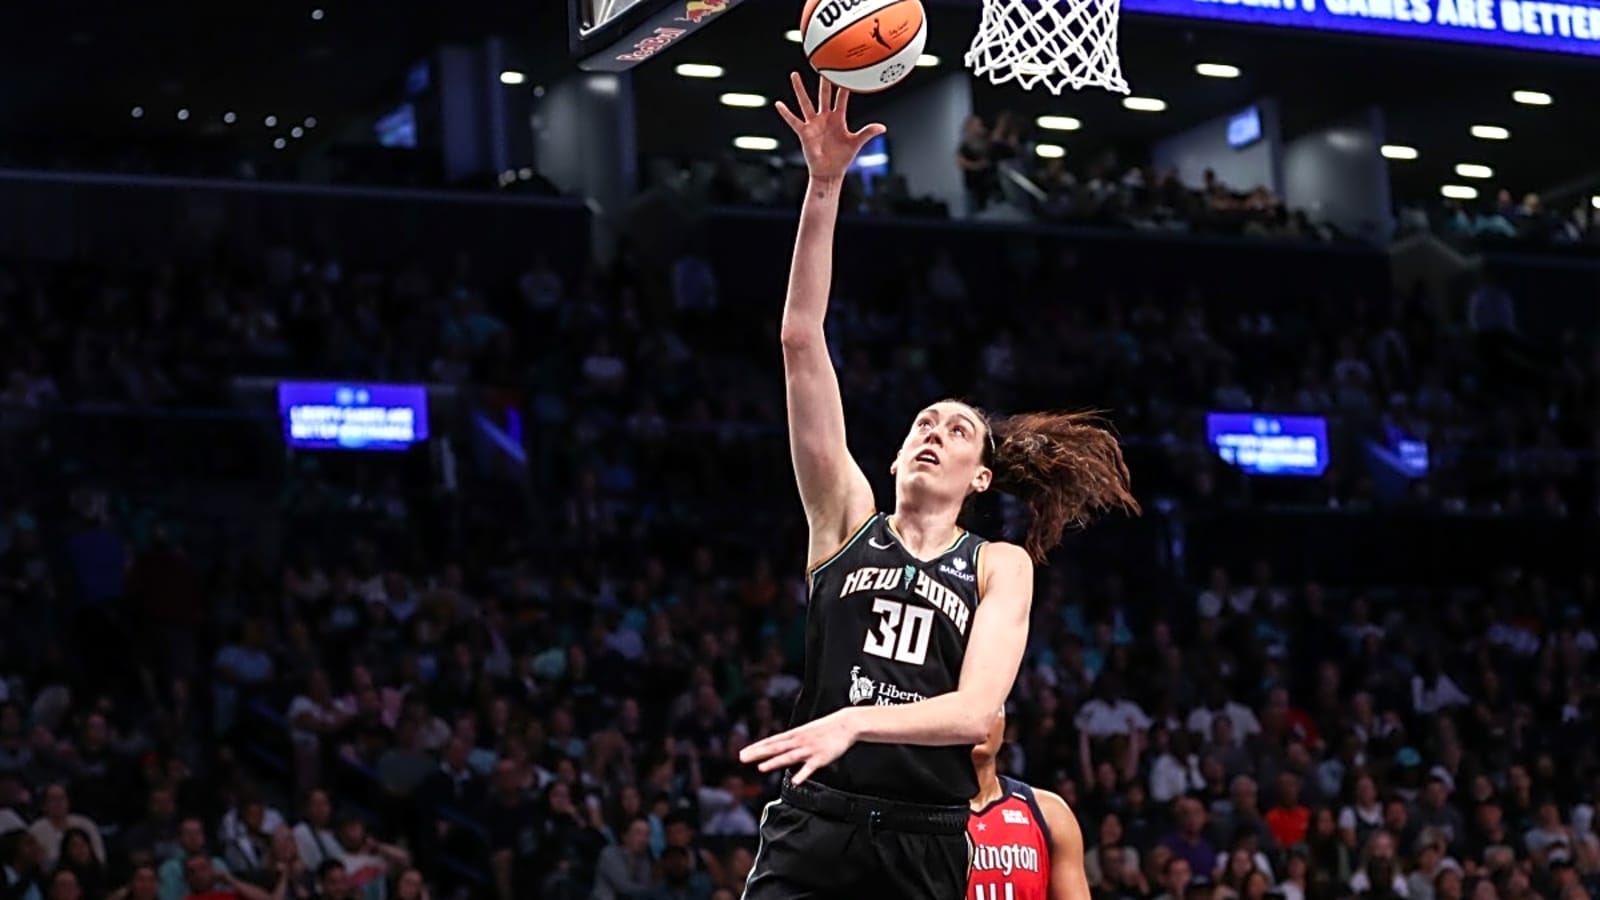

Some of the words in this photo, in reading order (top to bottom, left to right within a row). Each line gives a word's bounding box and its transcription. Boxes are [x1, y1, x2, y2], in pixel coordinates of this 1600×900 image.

[1437, 0, 1497, 30] ARE
[940, 564, 975, 582] BARCLAYS
[840, 567, 903, 599] NEW
[914, 569, 970, 636] YORK
[863, 597, 935, 665] 30
